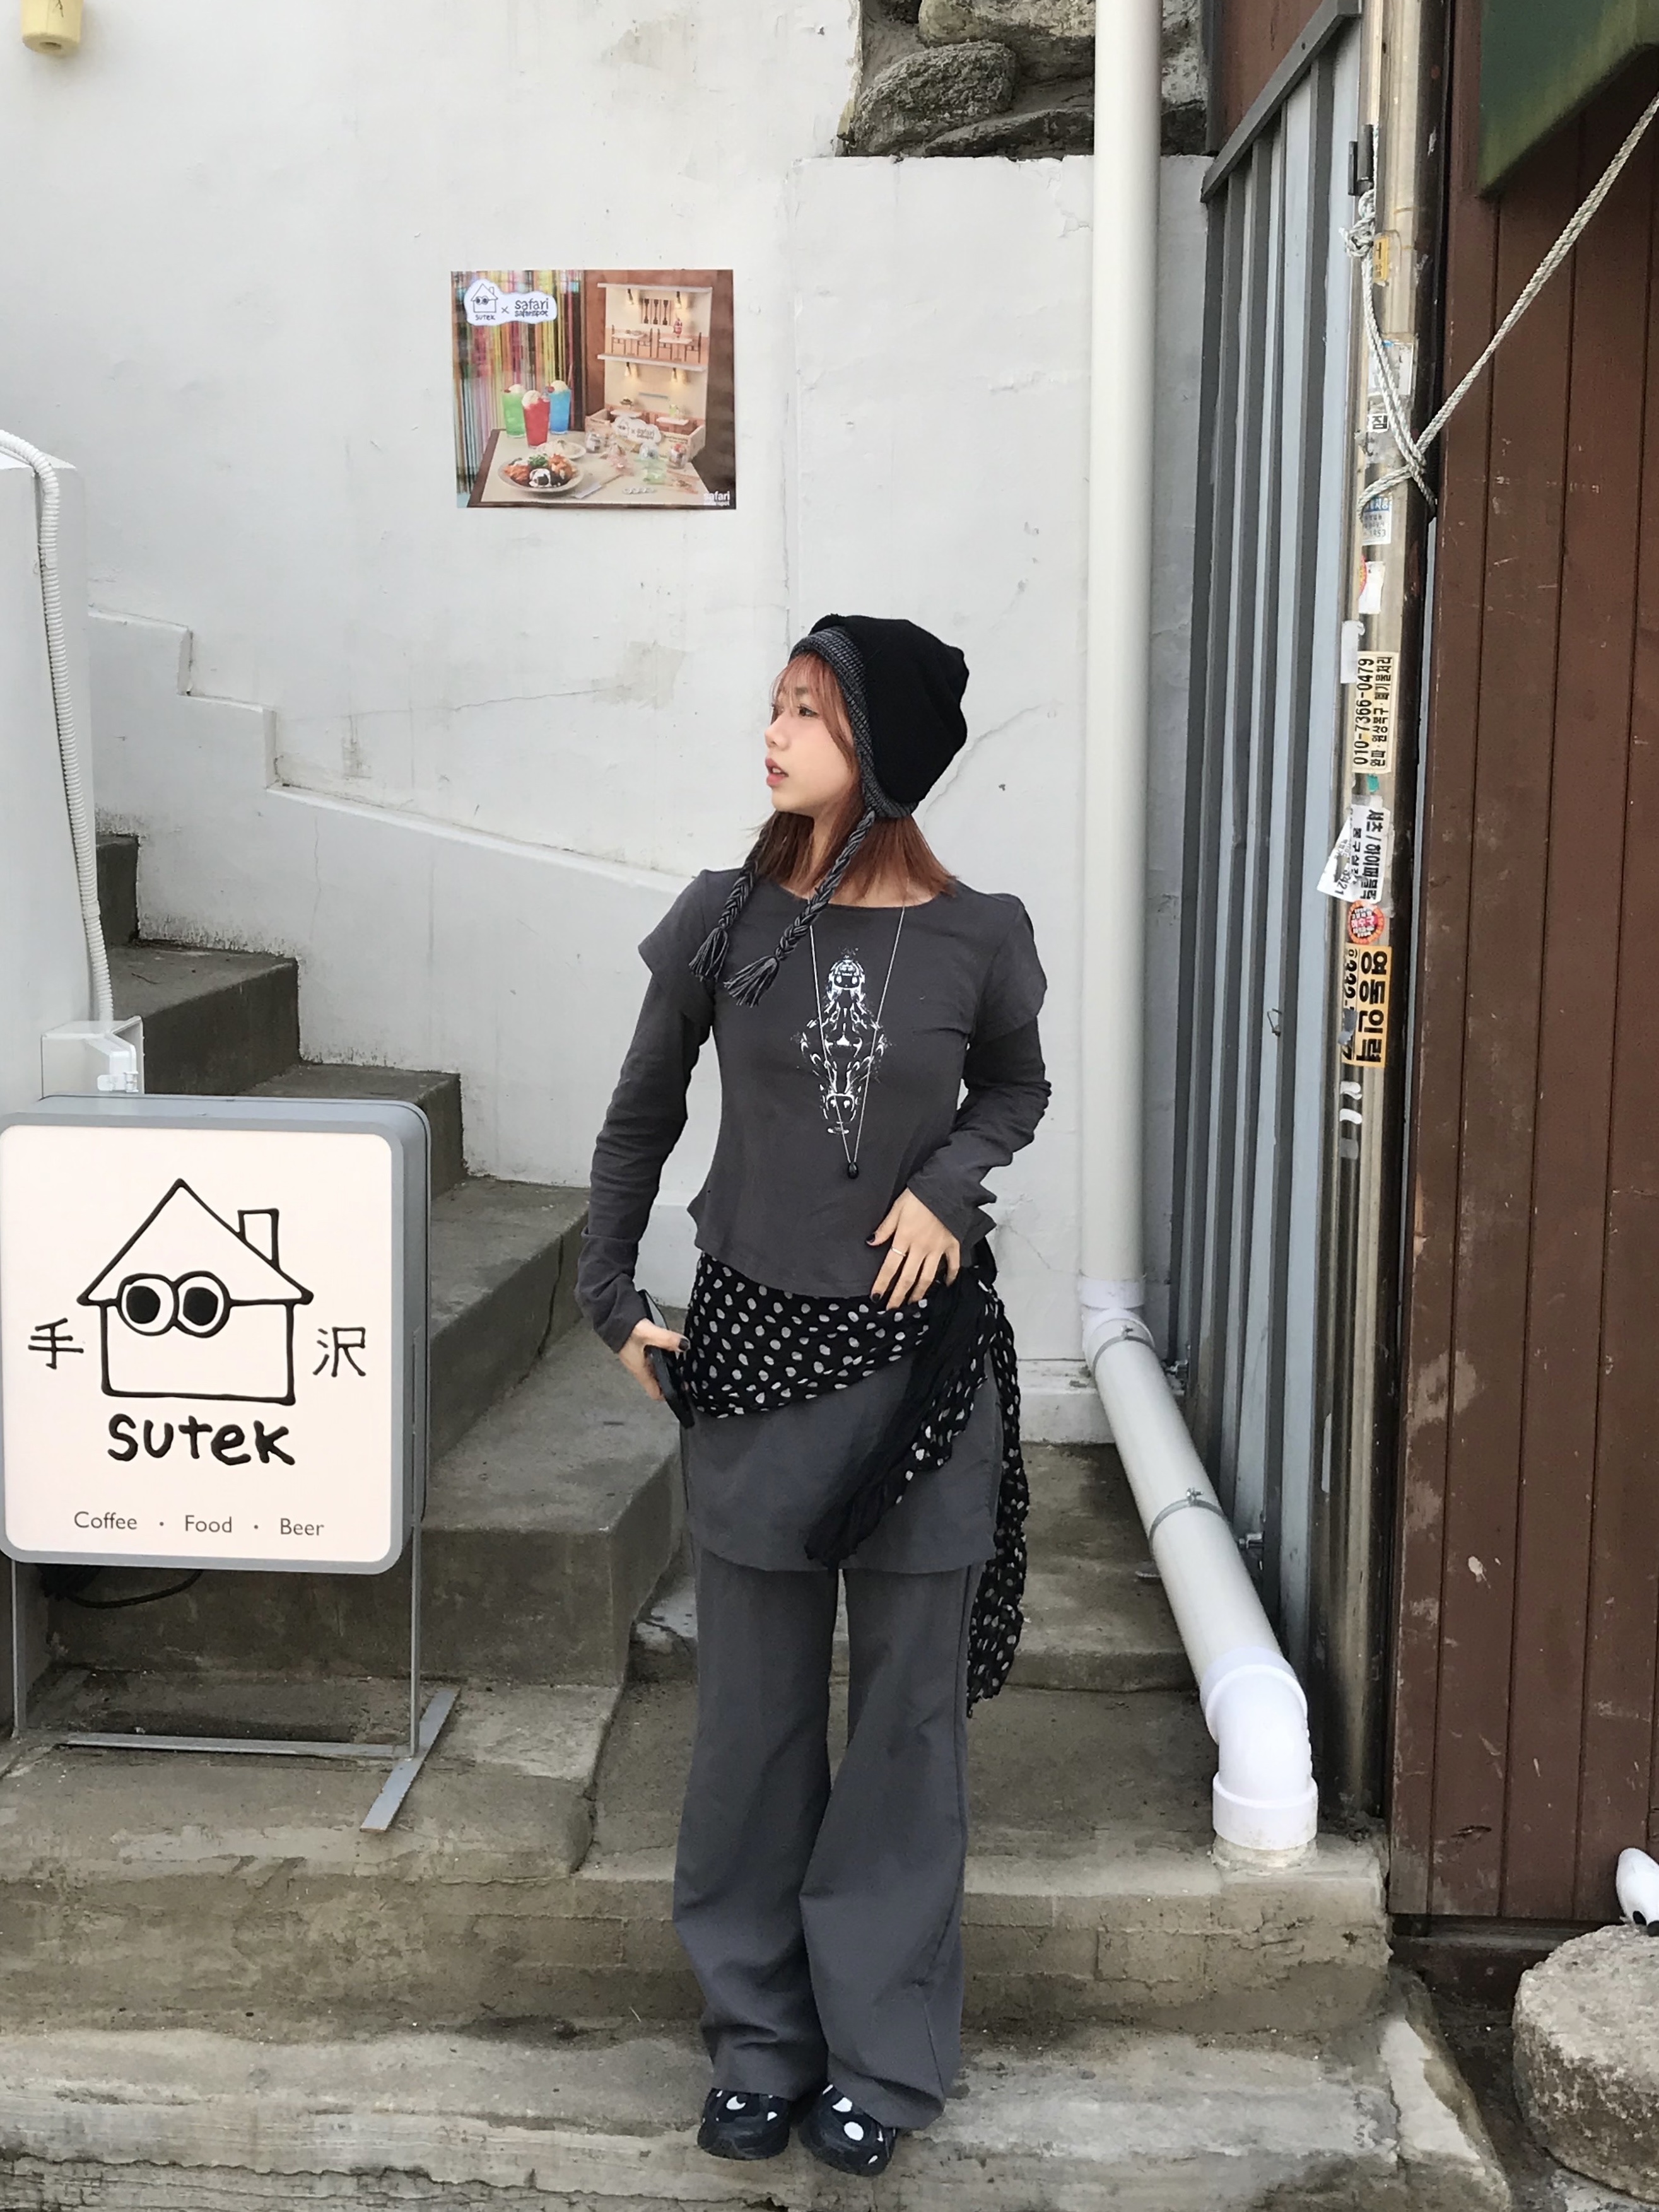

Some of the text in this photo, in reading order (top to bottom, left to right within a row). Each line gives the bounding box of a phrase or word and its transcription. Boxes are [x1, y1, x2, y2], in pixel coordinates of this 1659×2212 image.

[514, 298, 549, 311] safari
[1353, 658, 1375, 765] 010-7366-0479
[1371, 707, 1389, 742] 원상복구
[1356, 951, 1388, 1062] 영동인력
[28, 1318, 366, 1378] 手 沢
[74, 1511, 324, 1536] Coffee Food Beer
